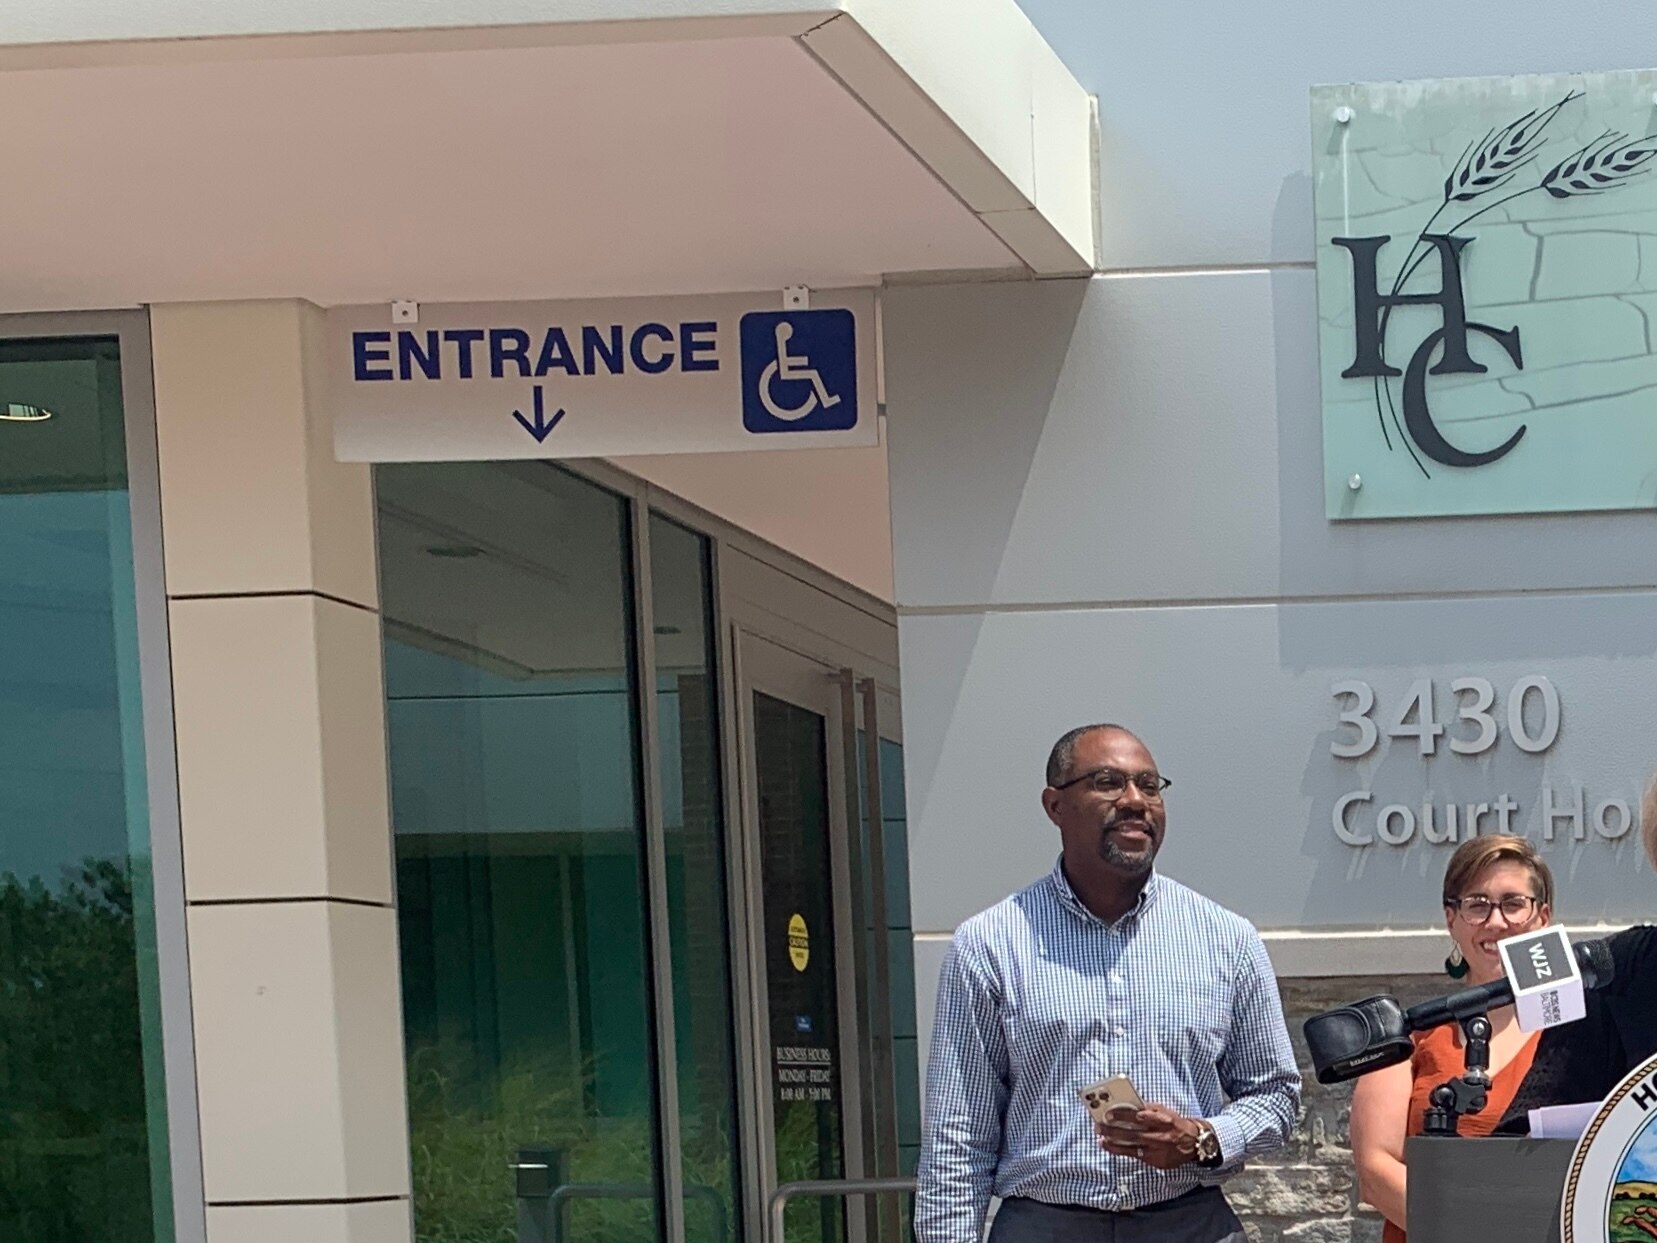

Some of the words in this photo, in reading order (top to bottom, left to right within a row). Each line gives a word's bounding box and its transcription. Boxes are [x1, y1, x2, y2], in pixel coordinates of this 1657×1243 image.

[352, 321, 719, 382] ENTRANCE
[1330, 675, 1561, 758] 3430
[1332, 791, 1517, 845] Court
[1543, 785, 1643, 840] Ho
[1529, 942, 1552, 979] WJZ
[1541, 992, 1552, 1026] BALTIMORE
[779, 1069, 806, 1082] MONDAY
[810, 1070, 830, 1082] FRIDAY
